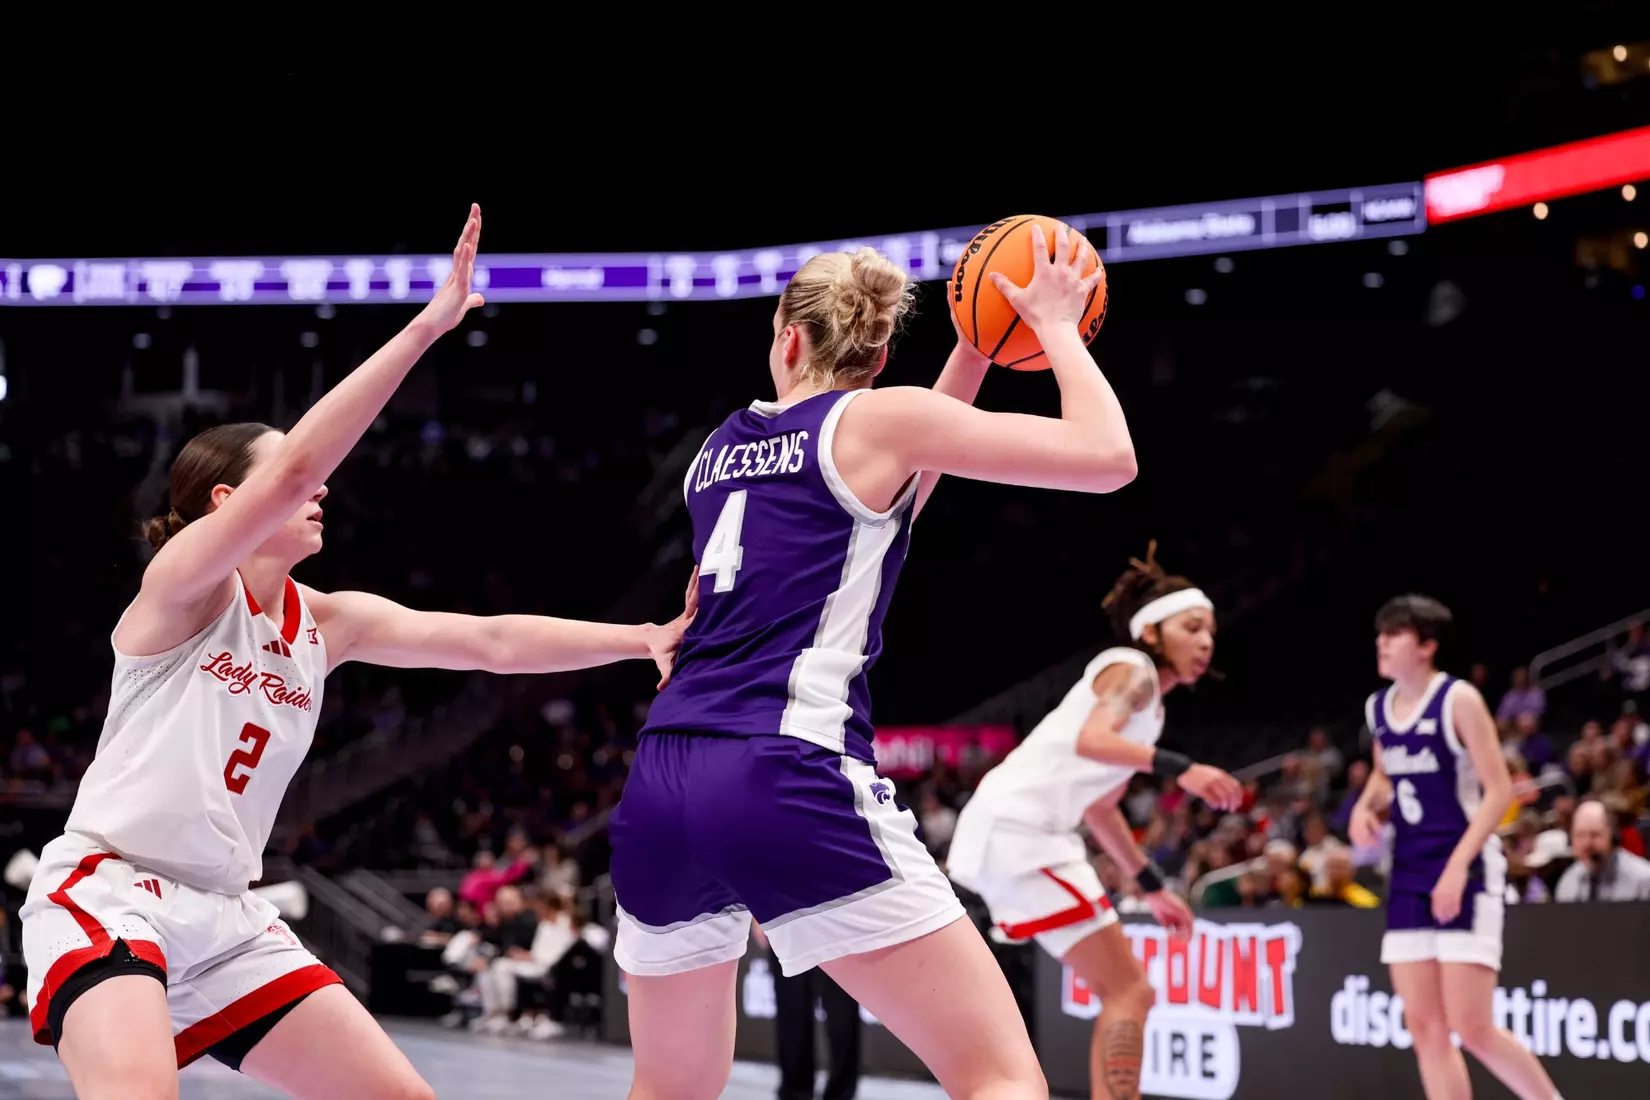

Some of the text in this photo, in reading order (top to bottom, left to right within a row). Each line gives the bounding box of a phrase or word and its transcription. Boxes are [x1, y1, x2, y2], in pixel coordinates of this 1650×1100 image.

[695, 431, 809, 493] CLAESSENS
[698, 489, 748, 594] 4
[200, 651, 258, 695] Lady
[224, 721, 271, 795] 2
[1397, 778, 1423, 825] 6
[1149, 1031, 1218, 1079] IRE
